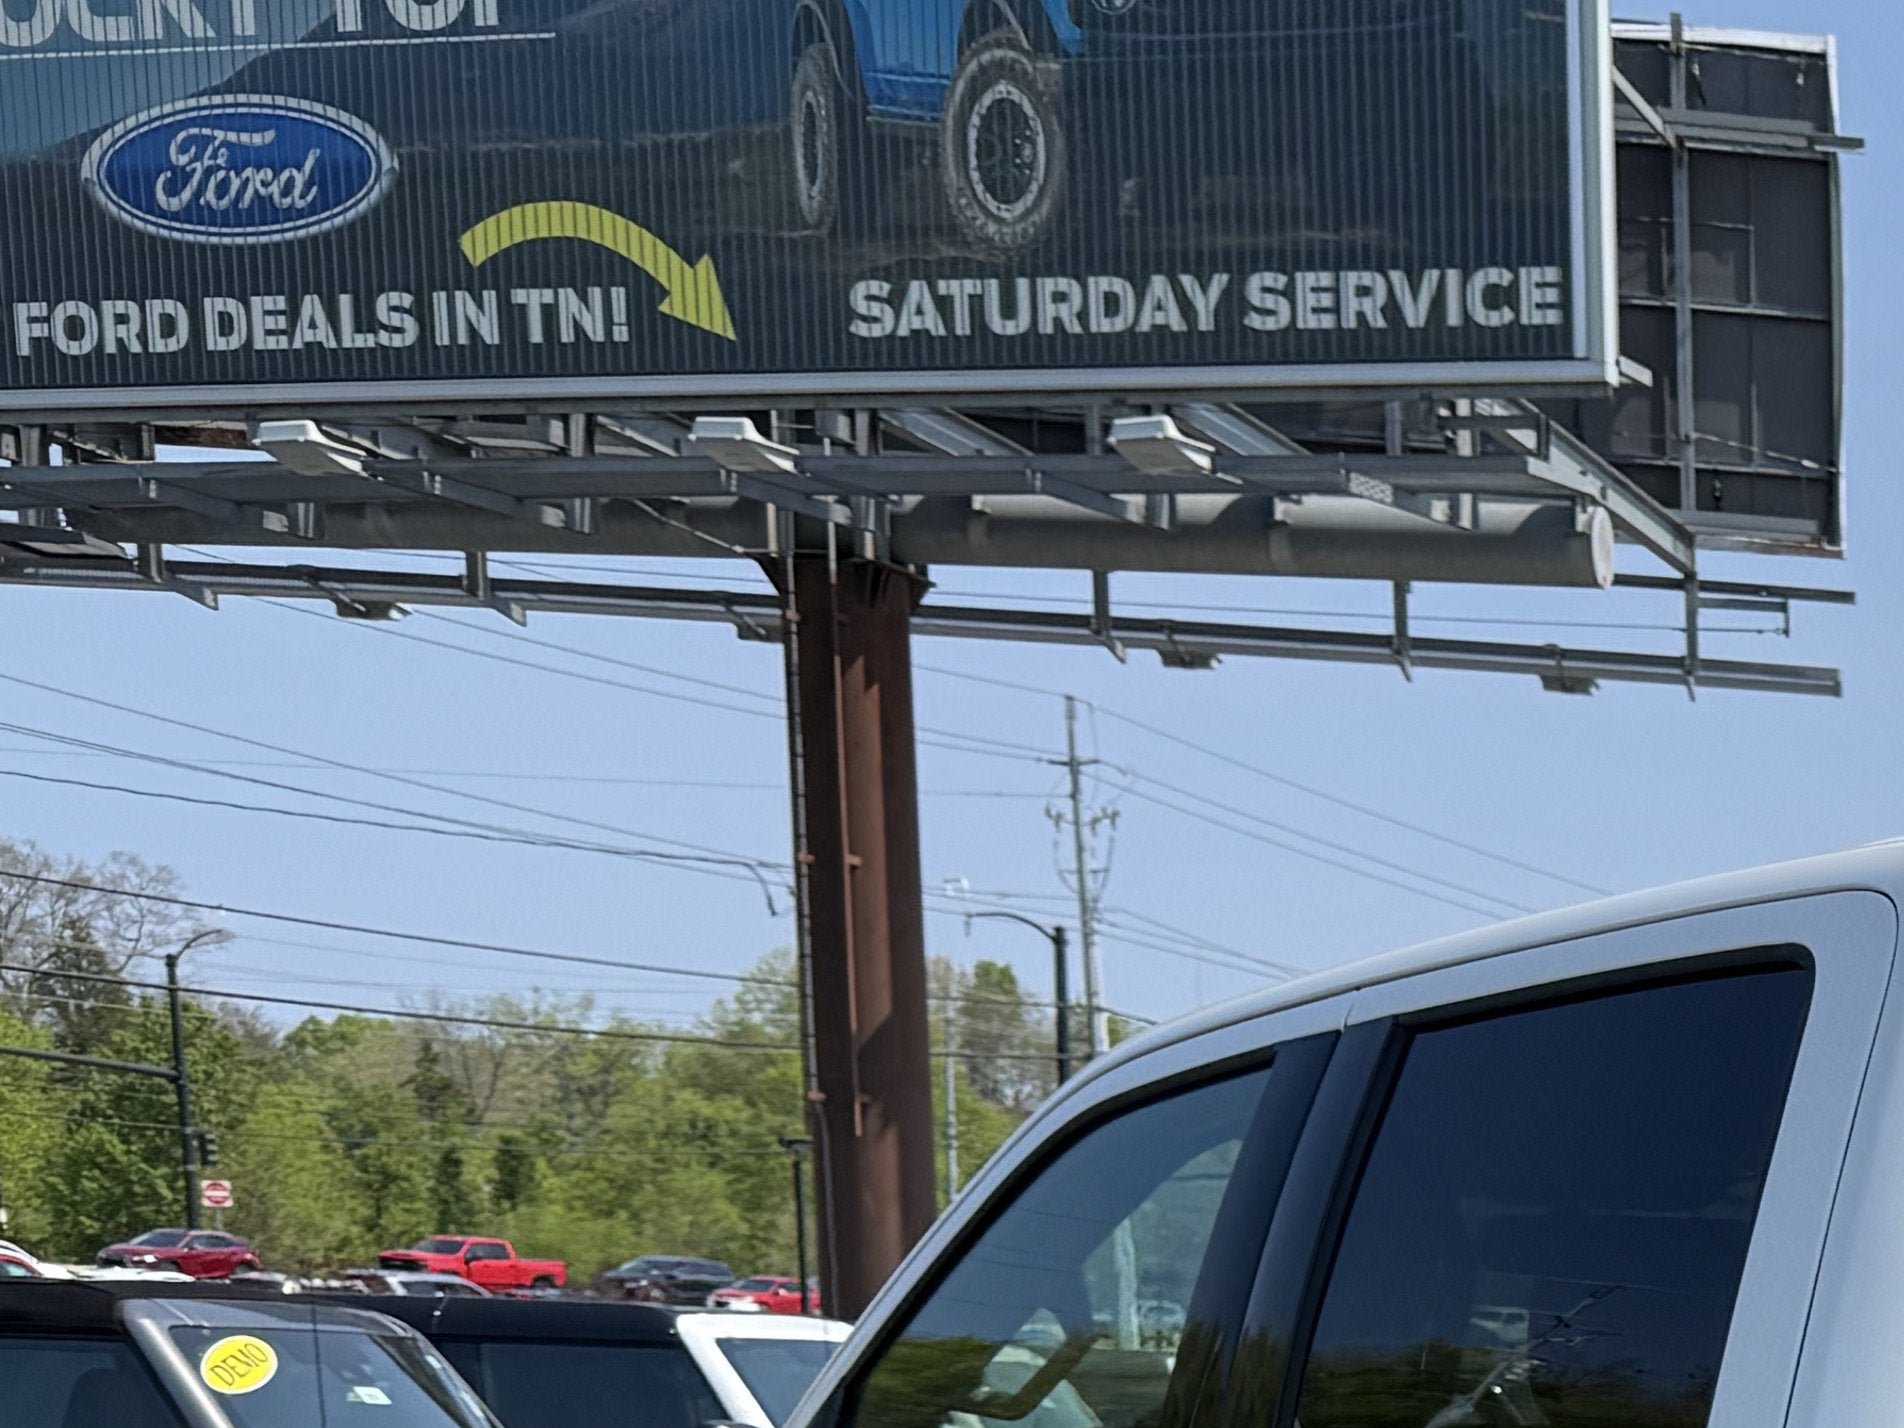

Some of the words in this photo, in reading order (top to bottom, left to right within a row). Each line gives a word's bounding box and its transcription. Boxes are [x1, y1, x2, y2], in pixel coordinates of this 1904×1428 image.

[155, 127, 320, 213] Ford
[13, 299, 190, 359] FORD
[203, 291, 416, 354] DEALS
[433, 289, 500, 347] IN
[509, 285, 630, 344] TN!
[847, 271, 1230, 341] SATURDAY
[1242, 264, 1565, 333] SERVICE
[210, 1342, 269, 1387] DEMO
